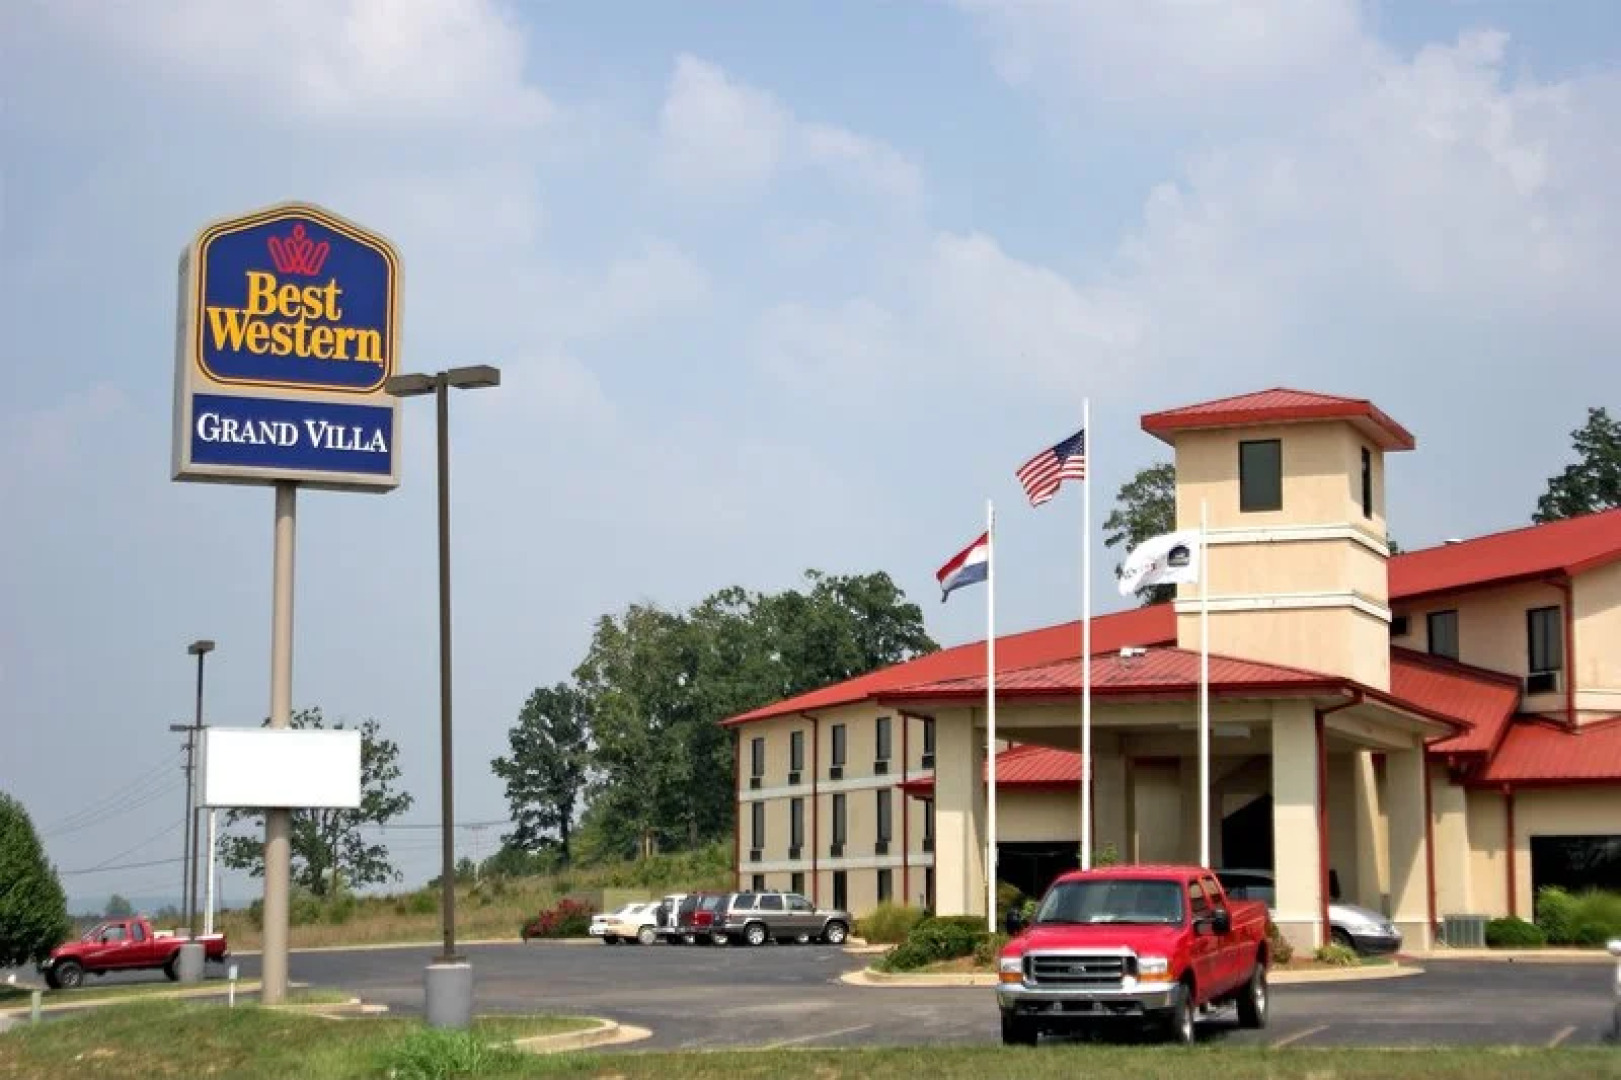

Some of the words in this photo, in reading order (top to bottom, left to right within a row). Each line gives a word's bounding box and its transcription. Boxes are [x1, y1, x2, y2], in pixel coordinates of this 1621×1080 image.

[246, 271, 342, 321] Best
[206, 307, 383, 363] Western
[197, 413, 299, 447] GRAND
[304, 419, 388, 453] VILLA
